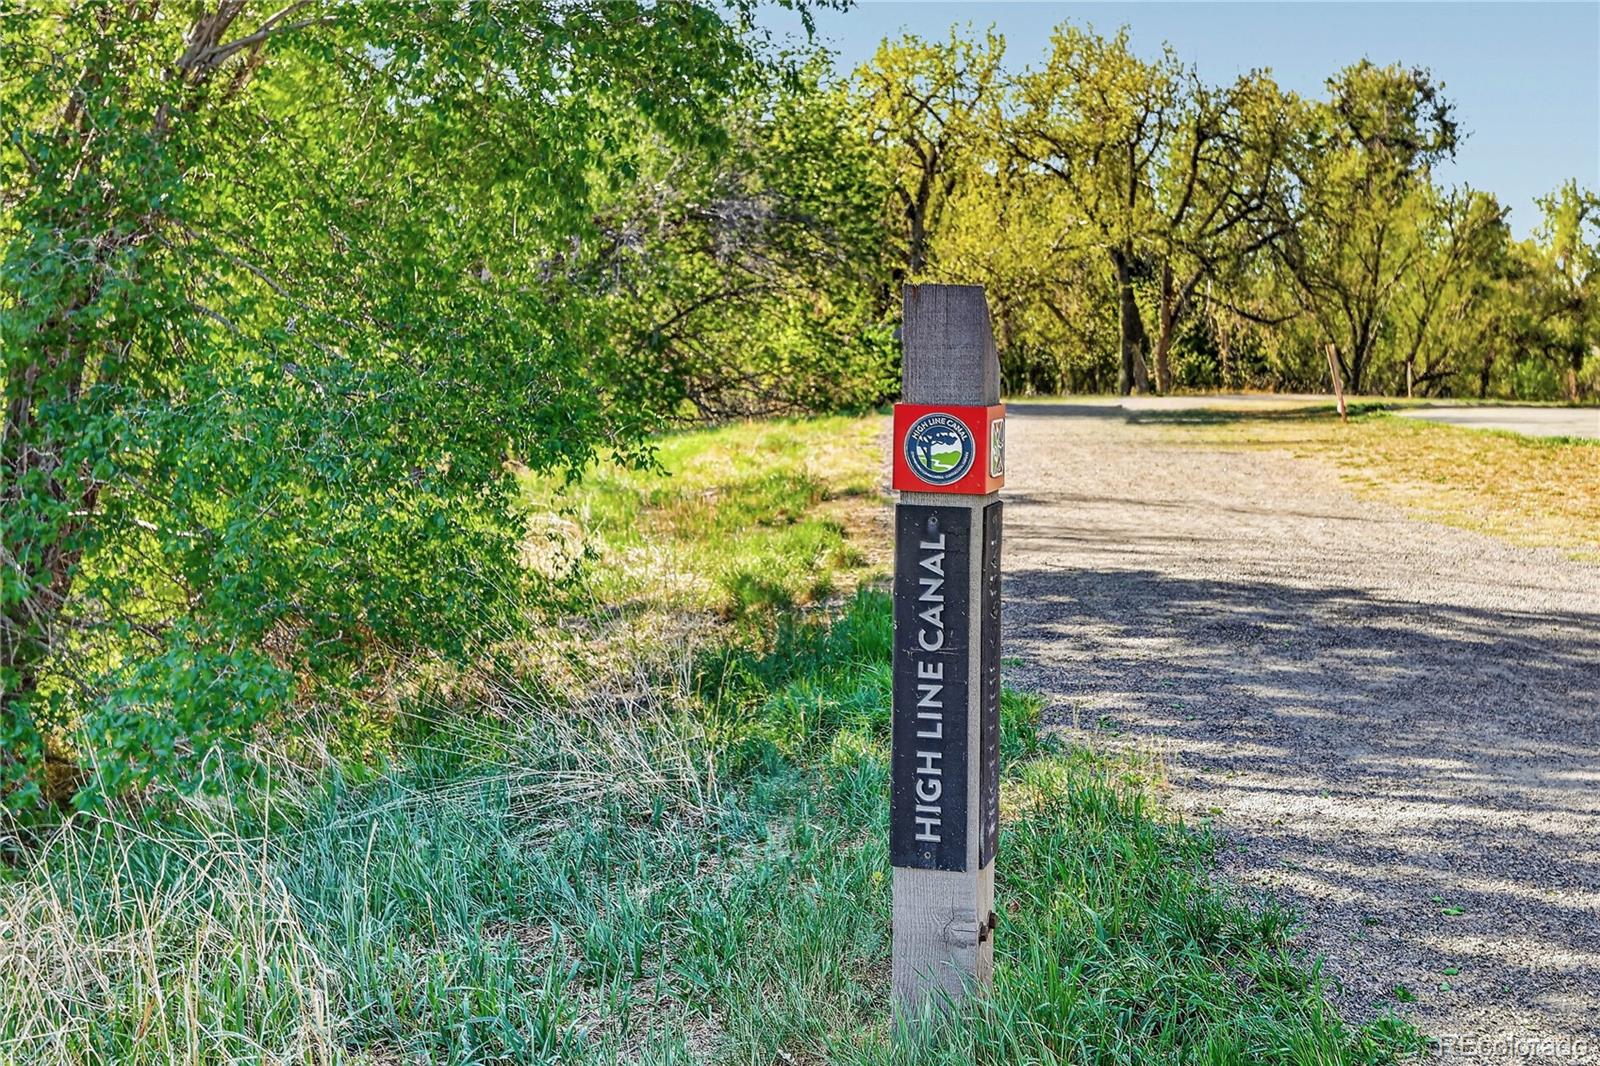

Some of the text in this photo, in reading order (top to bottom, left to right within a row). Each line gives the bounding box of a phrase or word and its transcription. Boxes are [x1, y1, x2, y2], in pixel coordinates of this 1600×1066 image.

[911, 417, 968, 442] HIGH LINE CANAL
[914, 533, 946, 844] HIGH LINE CANAL
